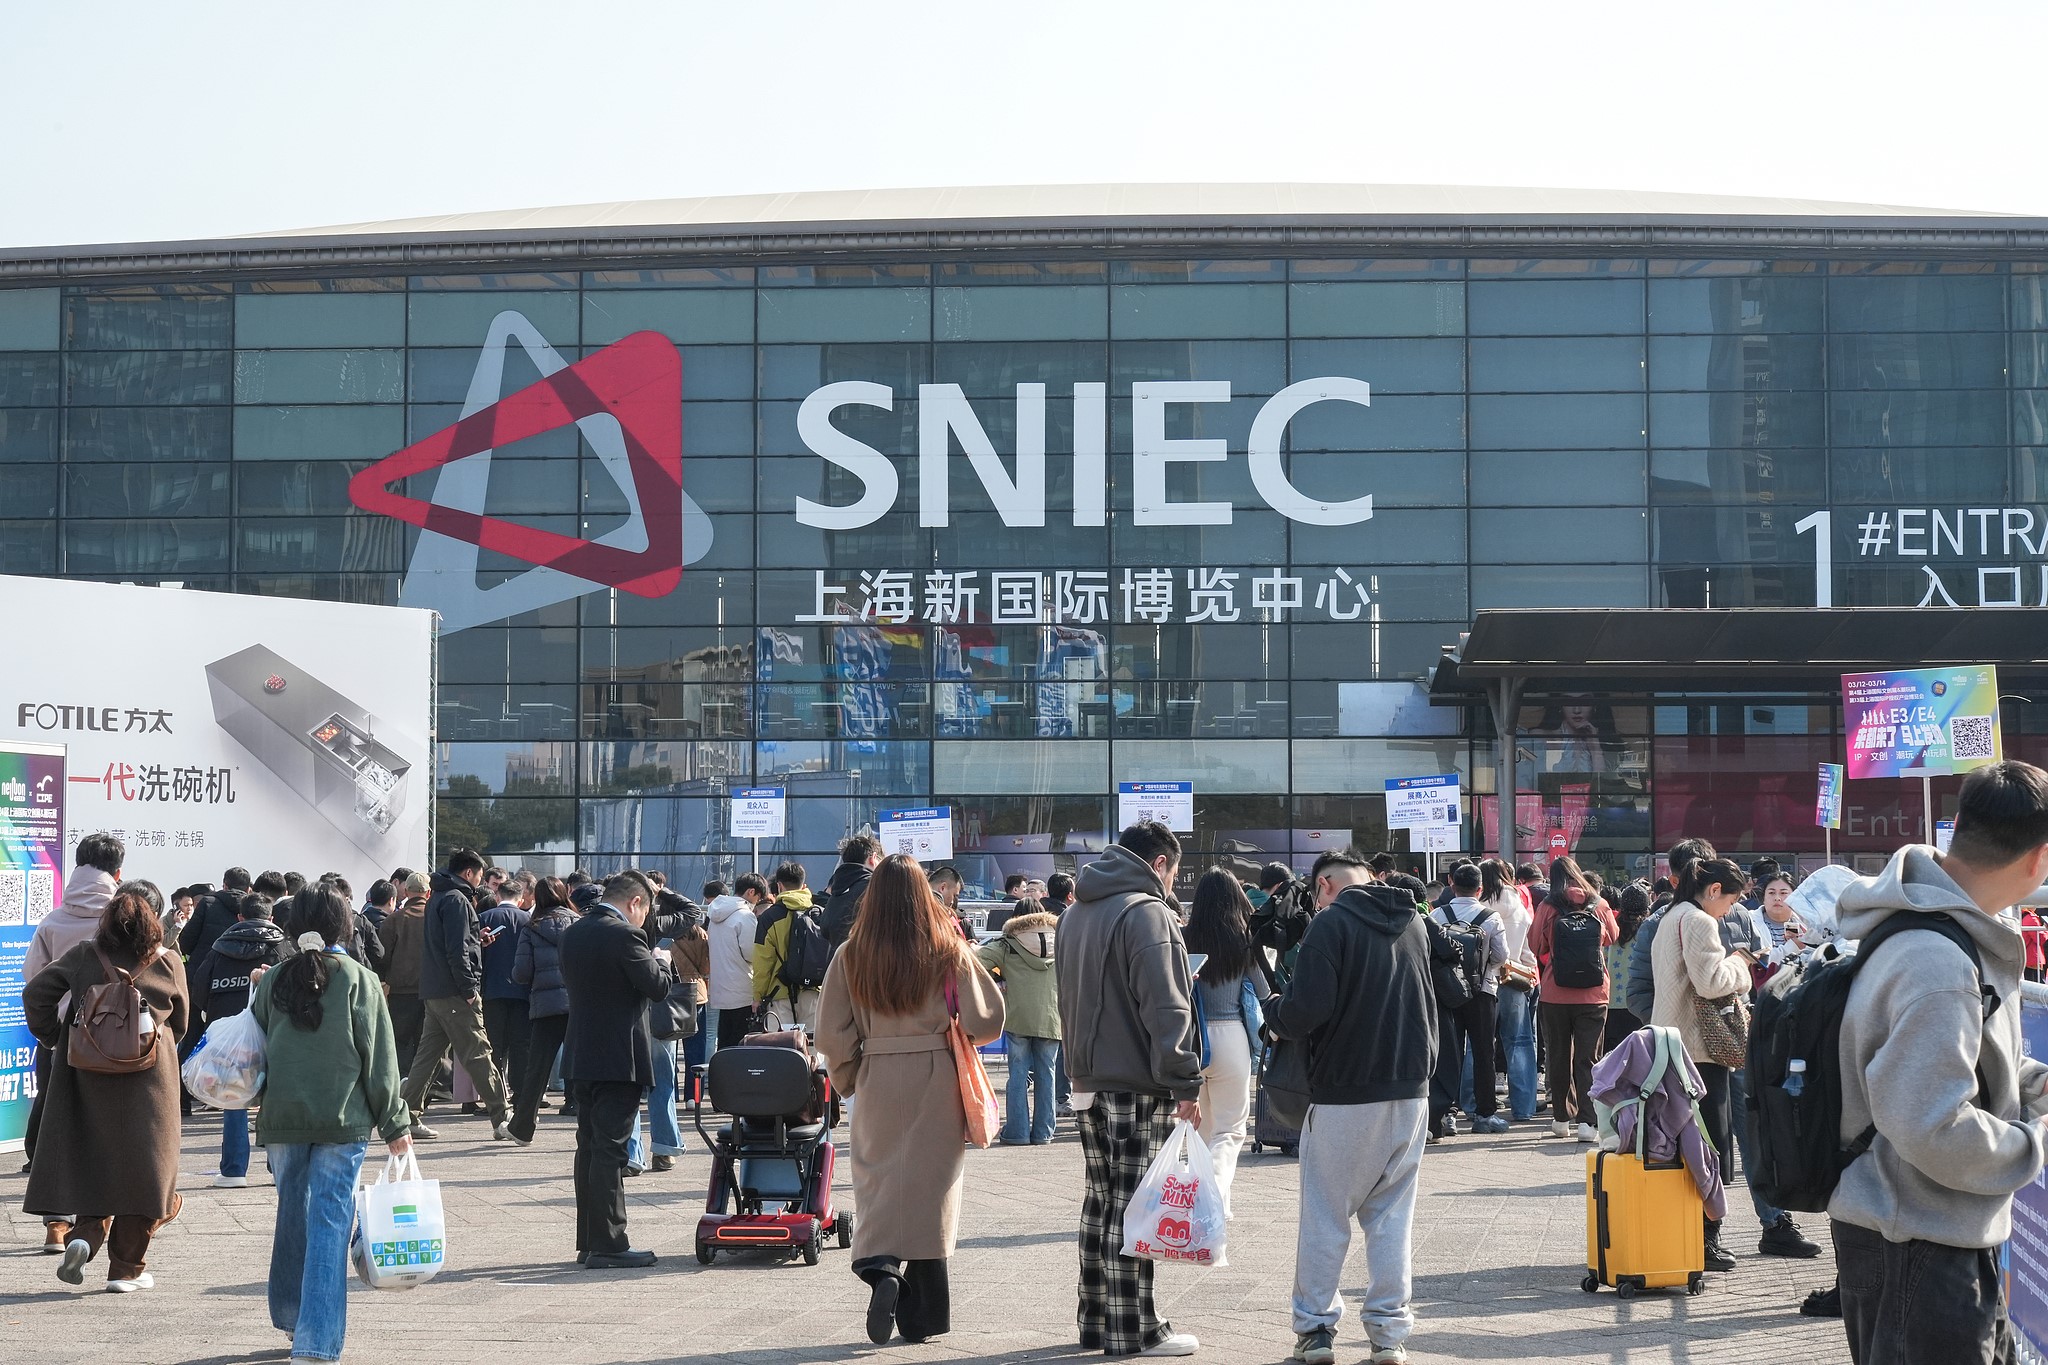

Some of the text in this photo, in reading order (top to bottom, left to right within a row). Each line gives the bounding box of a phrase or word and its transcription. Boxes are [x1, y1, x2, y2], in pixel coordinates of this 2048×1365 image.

[796, 376, 1373, 530] SNIEC
[1795, 511, 1832, 609] 1
[795, 567, 1371, 624] 上海新国际博览中心
[1917, 565, 2048, 608] 入口
[1848, 680, 1886, 688] 03/12-03/14
[18, 703, 173, 734] FOTILE 方太
[1890, 706, 1936, 723] E3/E4
[1854, 726, 1897, 749] 来都来了
[1870, 752, 1888, 761] 文创
[68, 762, 235, 804] 一代洗碗机
[1408, 791, 1437, 800] 展商入口
[135, 829, 166, 847] 洗碗
[174, 830, 204, 848] 洗锅
[211, 976, 250, 990] BOSID
